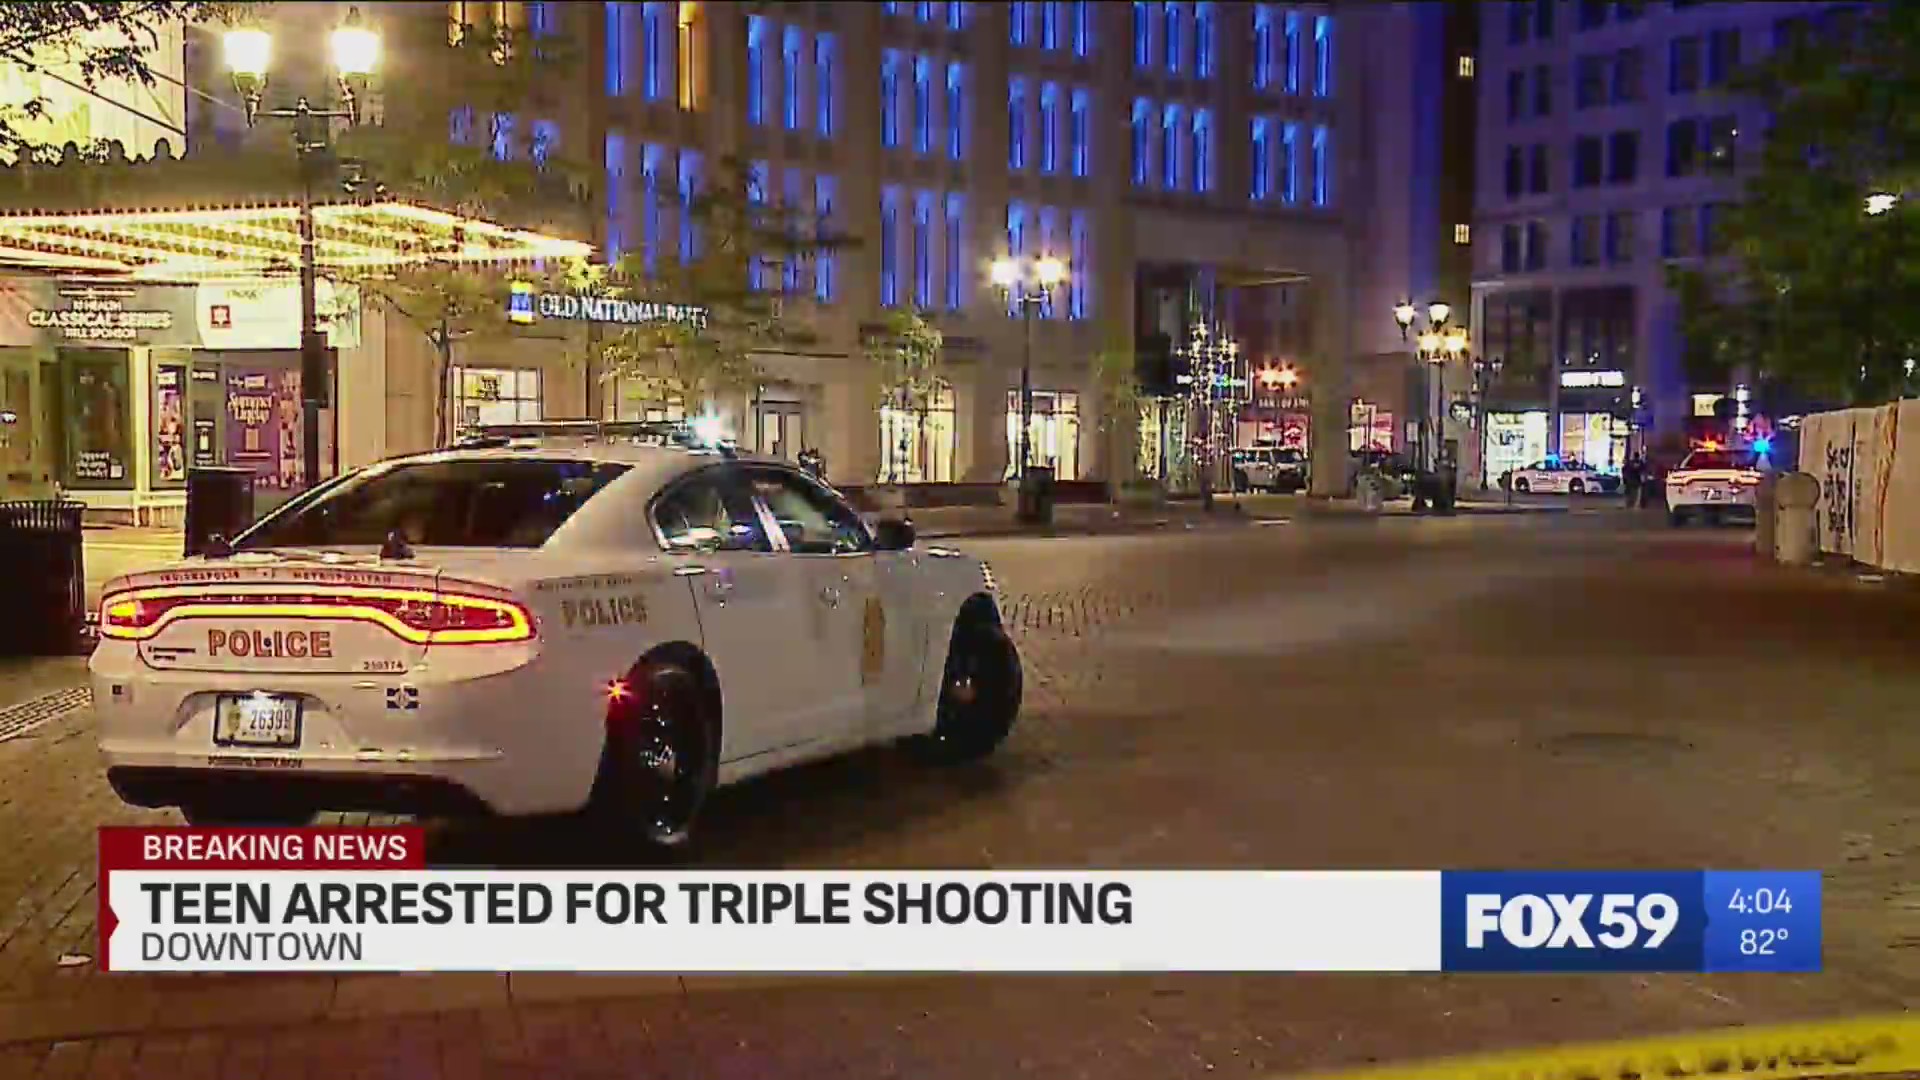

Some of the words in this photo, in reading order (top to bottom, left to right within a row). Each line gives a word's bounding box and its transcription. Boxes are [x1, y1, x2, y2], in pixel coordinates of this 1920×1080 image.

[541, 294, 577, 318] OLD
[28, 310, 116, 327] CLASSICAL
[118, 311, 172, 328] SERIES
[208, 628, 333, 658] POLICE
